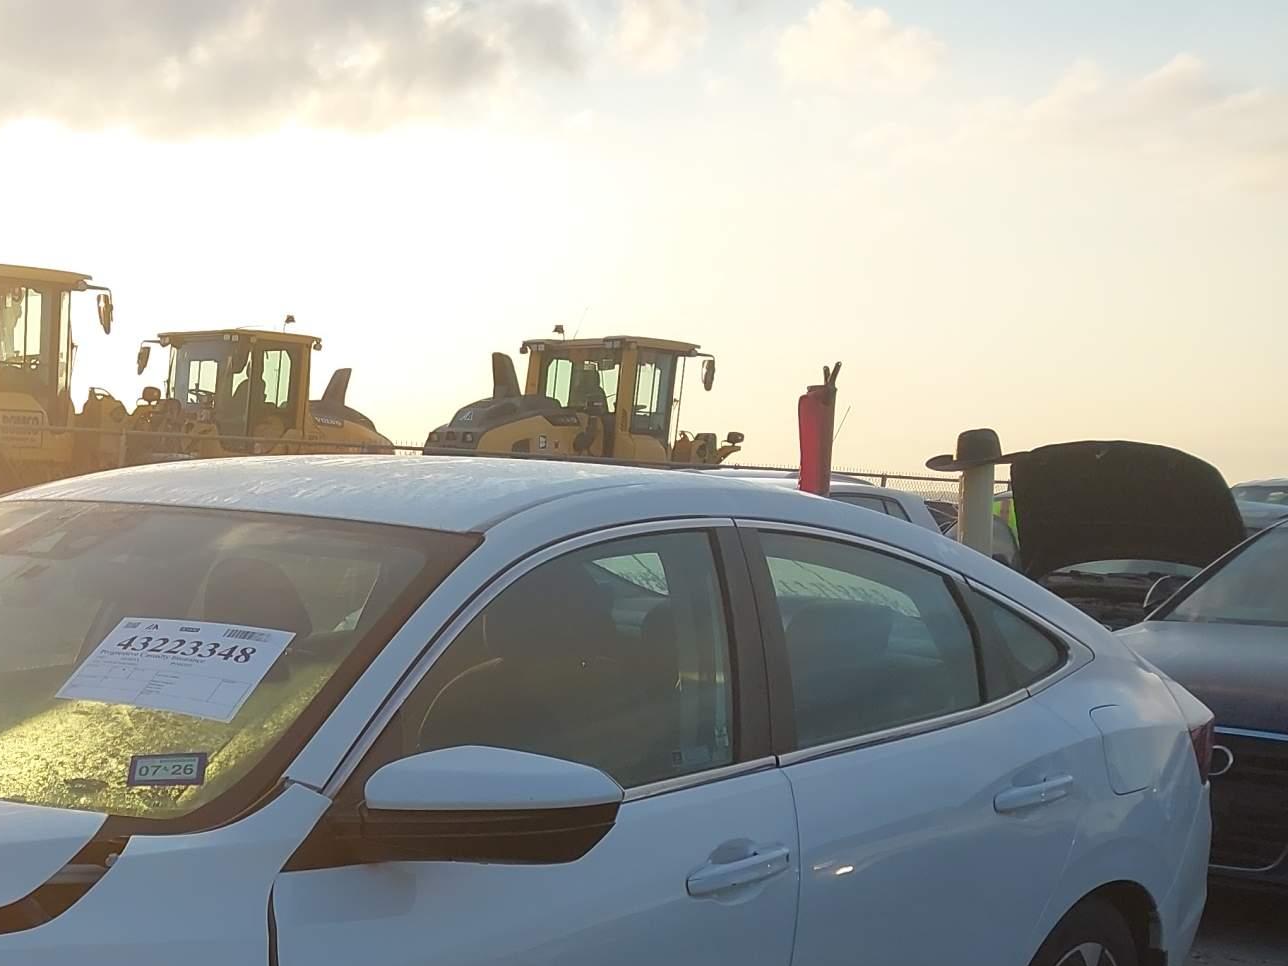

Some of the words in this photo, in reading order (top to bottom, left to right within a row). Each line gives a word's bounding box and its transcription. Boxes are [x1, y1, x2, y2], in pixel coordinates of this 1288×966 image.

[116, 635, 257, 664] 43223348
[138, 764, 162, 777] 07
[171, 763, 195, 776] 26
